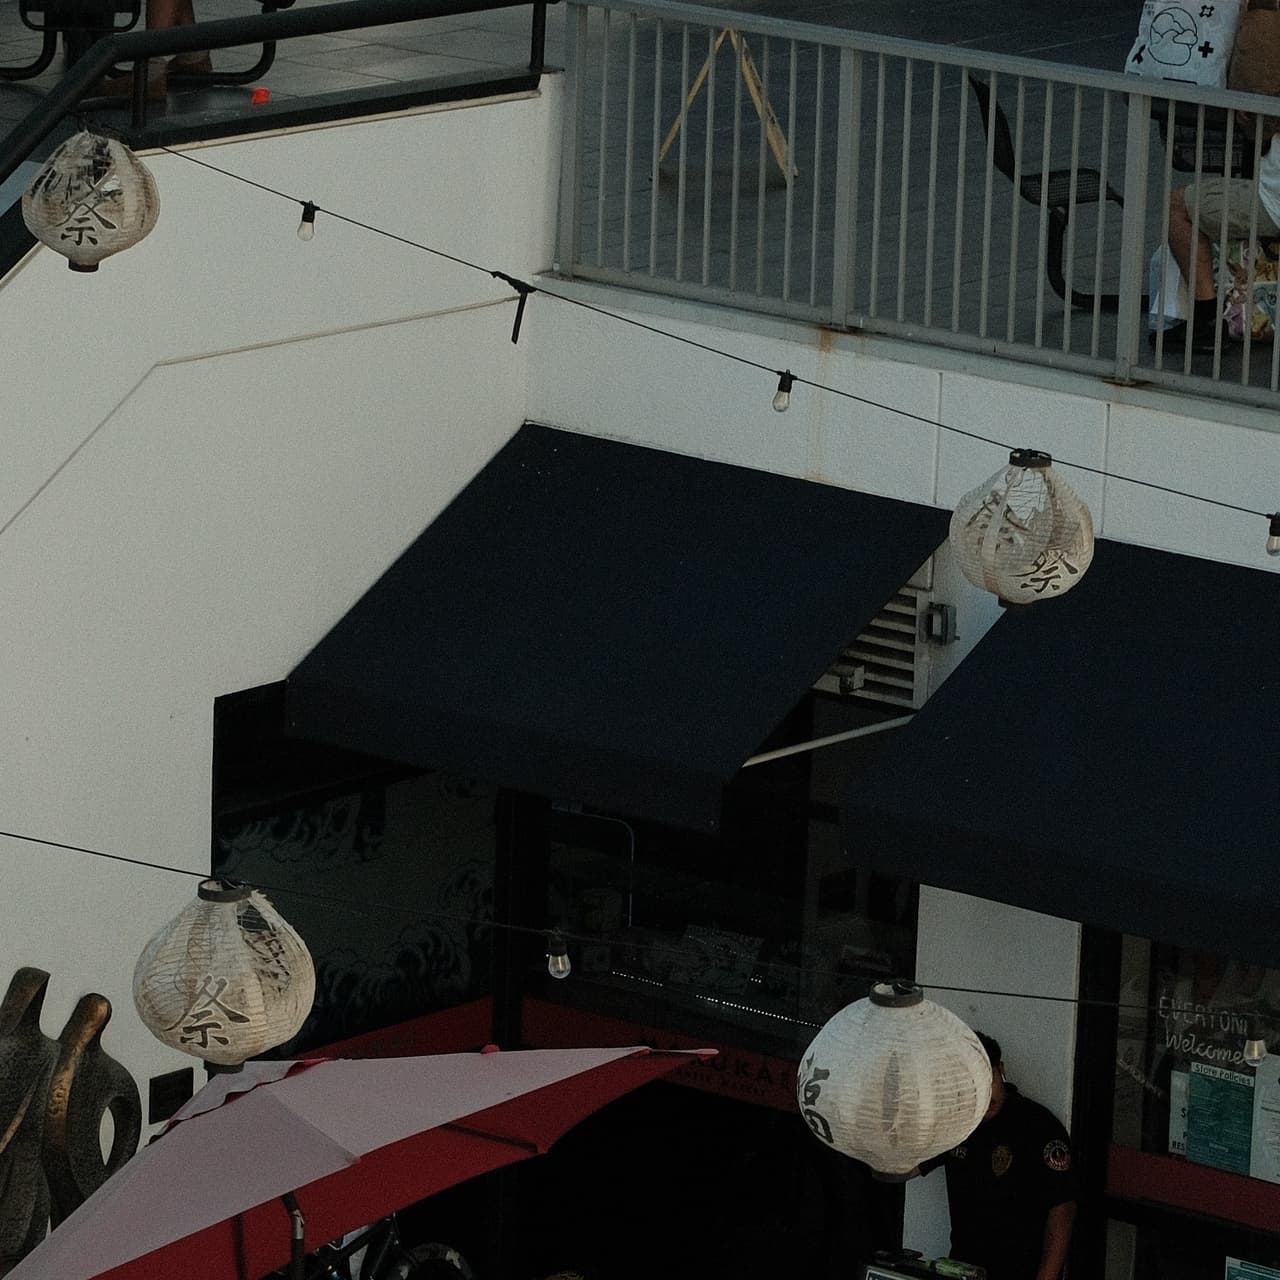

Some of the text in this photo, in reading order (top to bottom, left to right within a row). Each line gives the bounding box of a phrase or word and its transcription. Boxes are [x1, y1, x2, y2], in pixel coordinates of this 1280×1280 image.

[1159, 996, 1249, 1034] EVERYON
[1165, 1029, 1246, 1066] Welcome
[1194, 1062, 1218, 1076] Store
